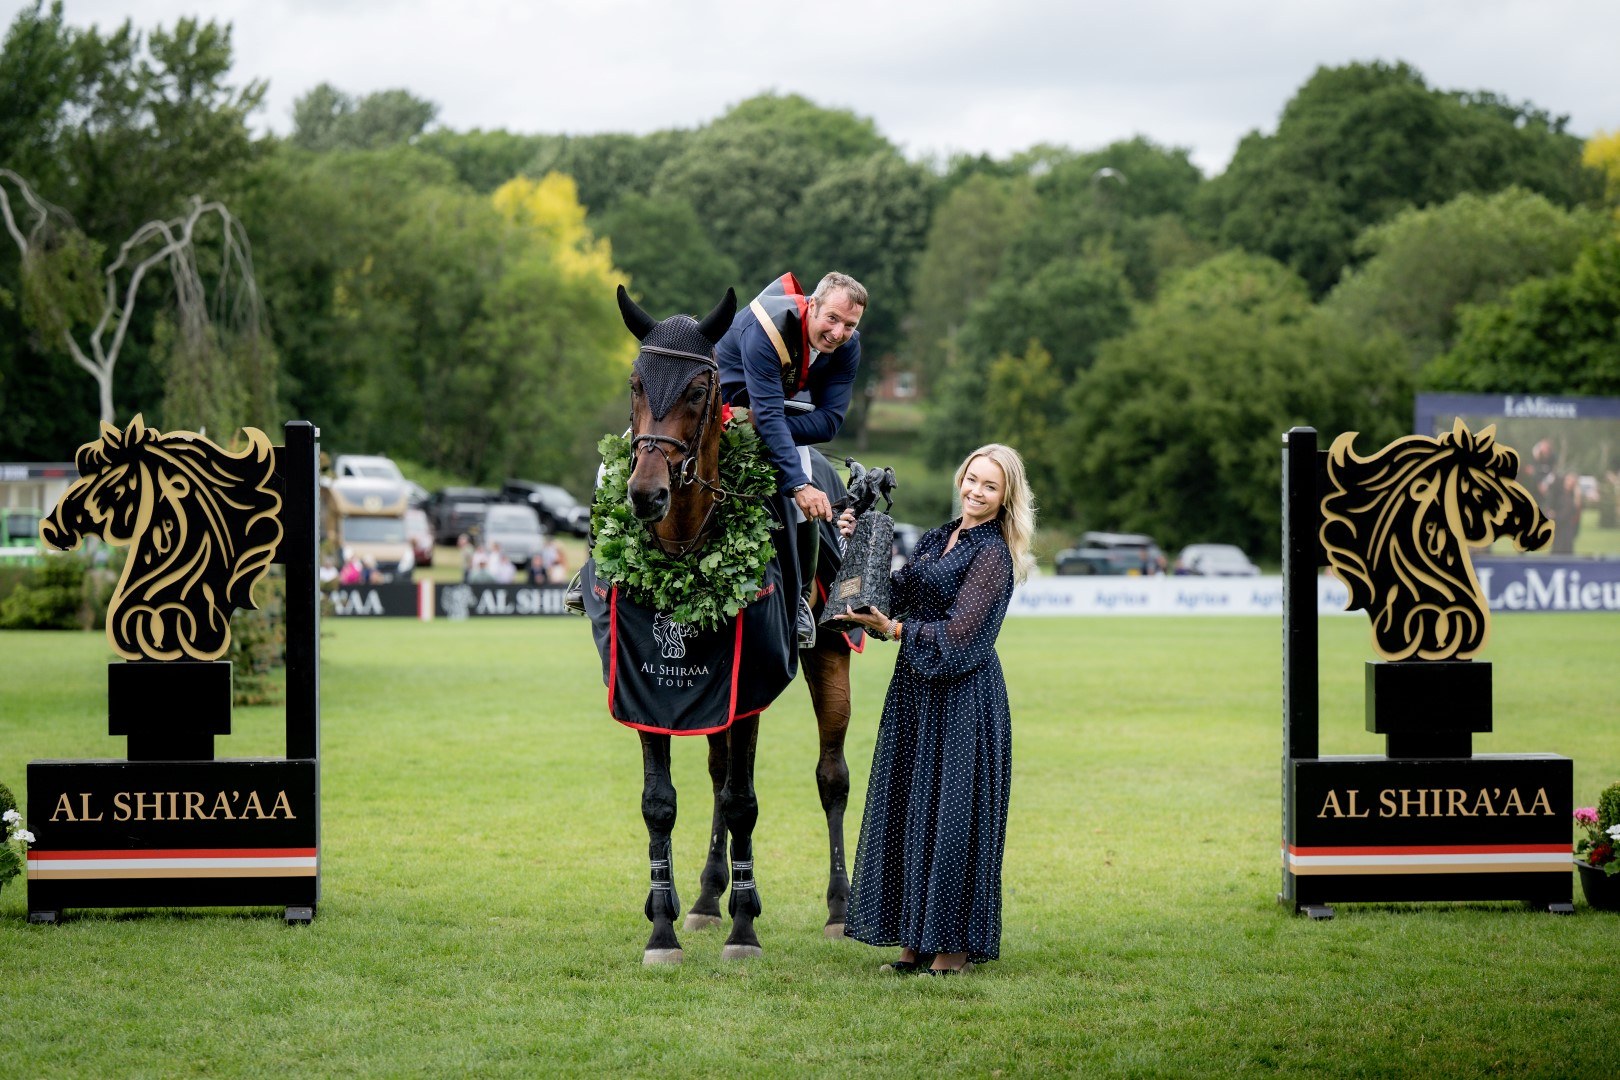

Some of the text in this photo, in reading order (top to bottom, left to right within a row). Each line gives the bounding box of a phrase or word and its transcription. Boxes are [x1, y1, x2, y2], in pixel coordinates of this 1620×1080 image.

[476, 588, 515, 614] AL
[1477, 567, 1620, 610] LeMieu
[641, 661, 710, 676] AL SHIRA'AA
[657, 677, 694, 688] TOUR
[49, 790, 297, 822] AL SHIRA'AA
[1317, 787, 1555, 818] AL SHIRA'AA
